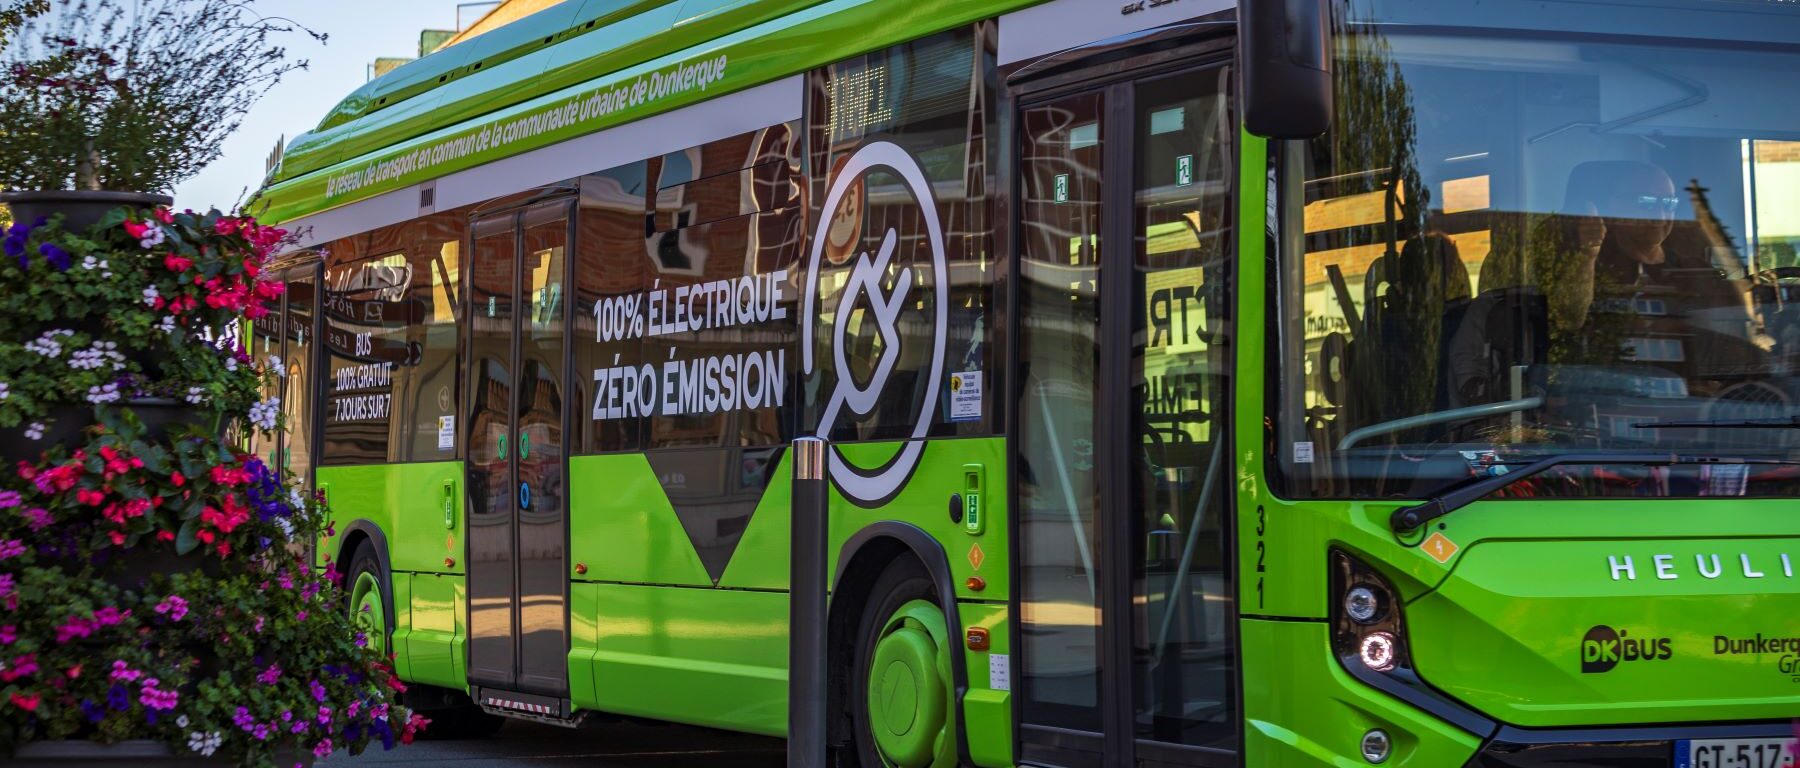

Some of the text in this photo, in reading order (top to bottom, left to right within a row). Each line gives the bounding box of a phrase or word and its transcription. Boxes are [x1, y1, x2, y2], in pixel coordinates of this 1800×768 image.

[335, 169, 363, 194] réseau
[364, 160, 376, 187] de
[376, 149, 418, 182] transport
[418, 150, 430, 168] en
[431, 133, 475, 164] commun
[475, 124, 490, 152] de
[491, 121, 502, 148] la
[502, 93, 580, 145] communauté
[579, 83, 628, 122] urbaine
[629, 76, 648, 107] de
[648, 54, 727, 100] Dunkerque
[593, 269, 788, 343] 100% ÉLECTRIQUE
[355, 331, 372, 357] BUS
[336, 361, 393, 391] 100% GRATUIT
[592, 346, 785, 421] ZÉRO ÉMISSION
[335, 393, 391, 422] 7 JOURS SUR 7
[1607, 553, 1794, 581] HEULI
